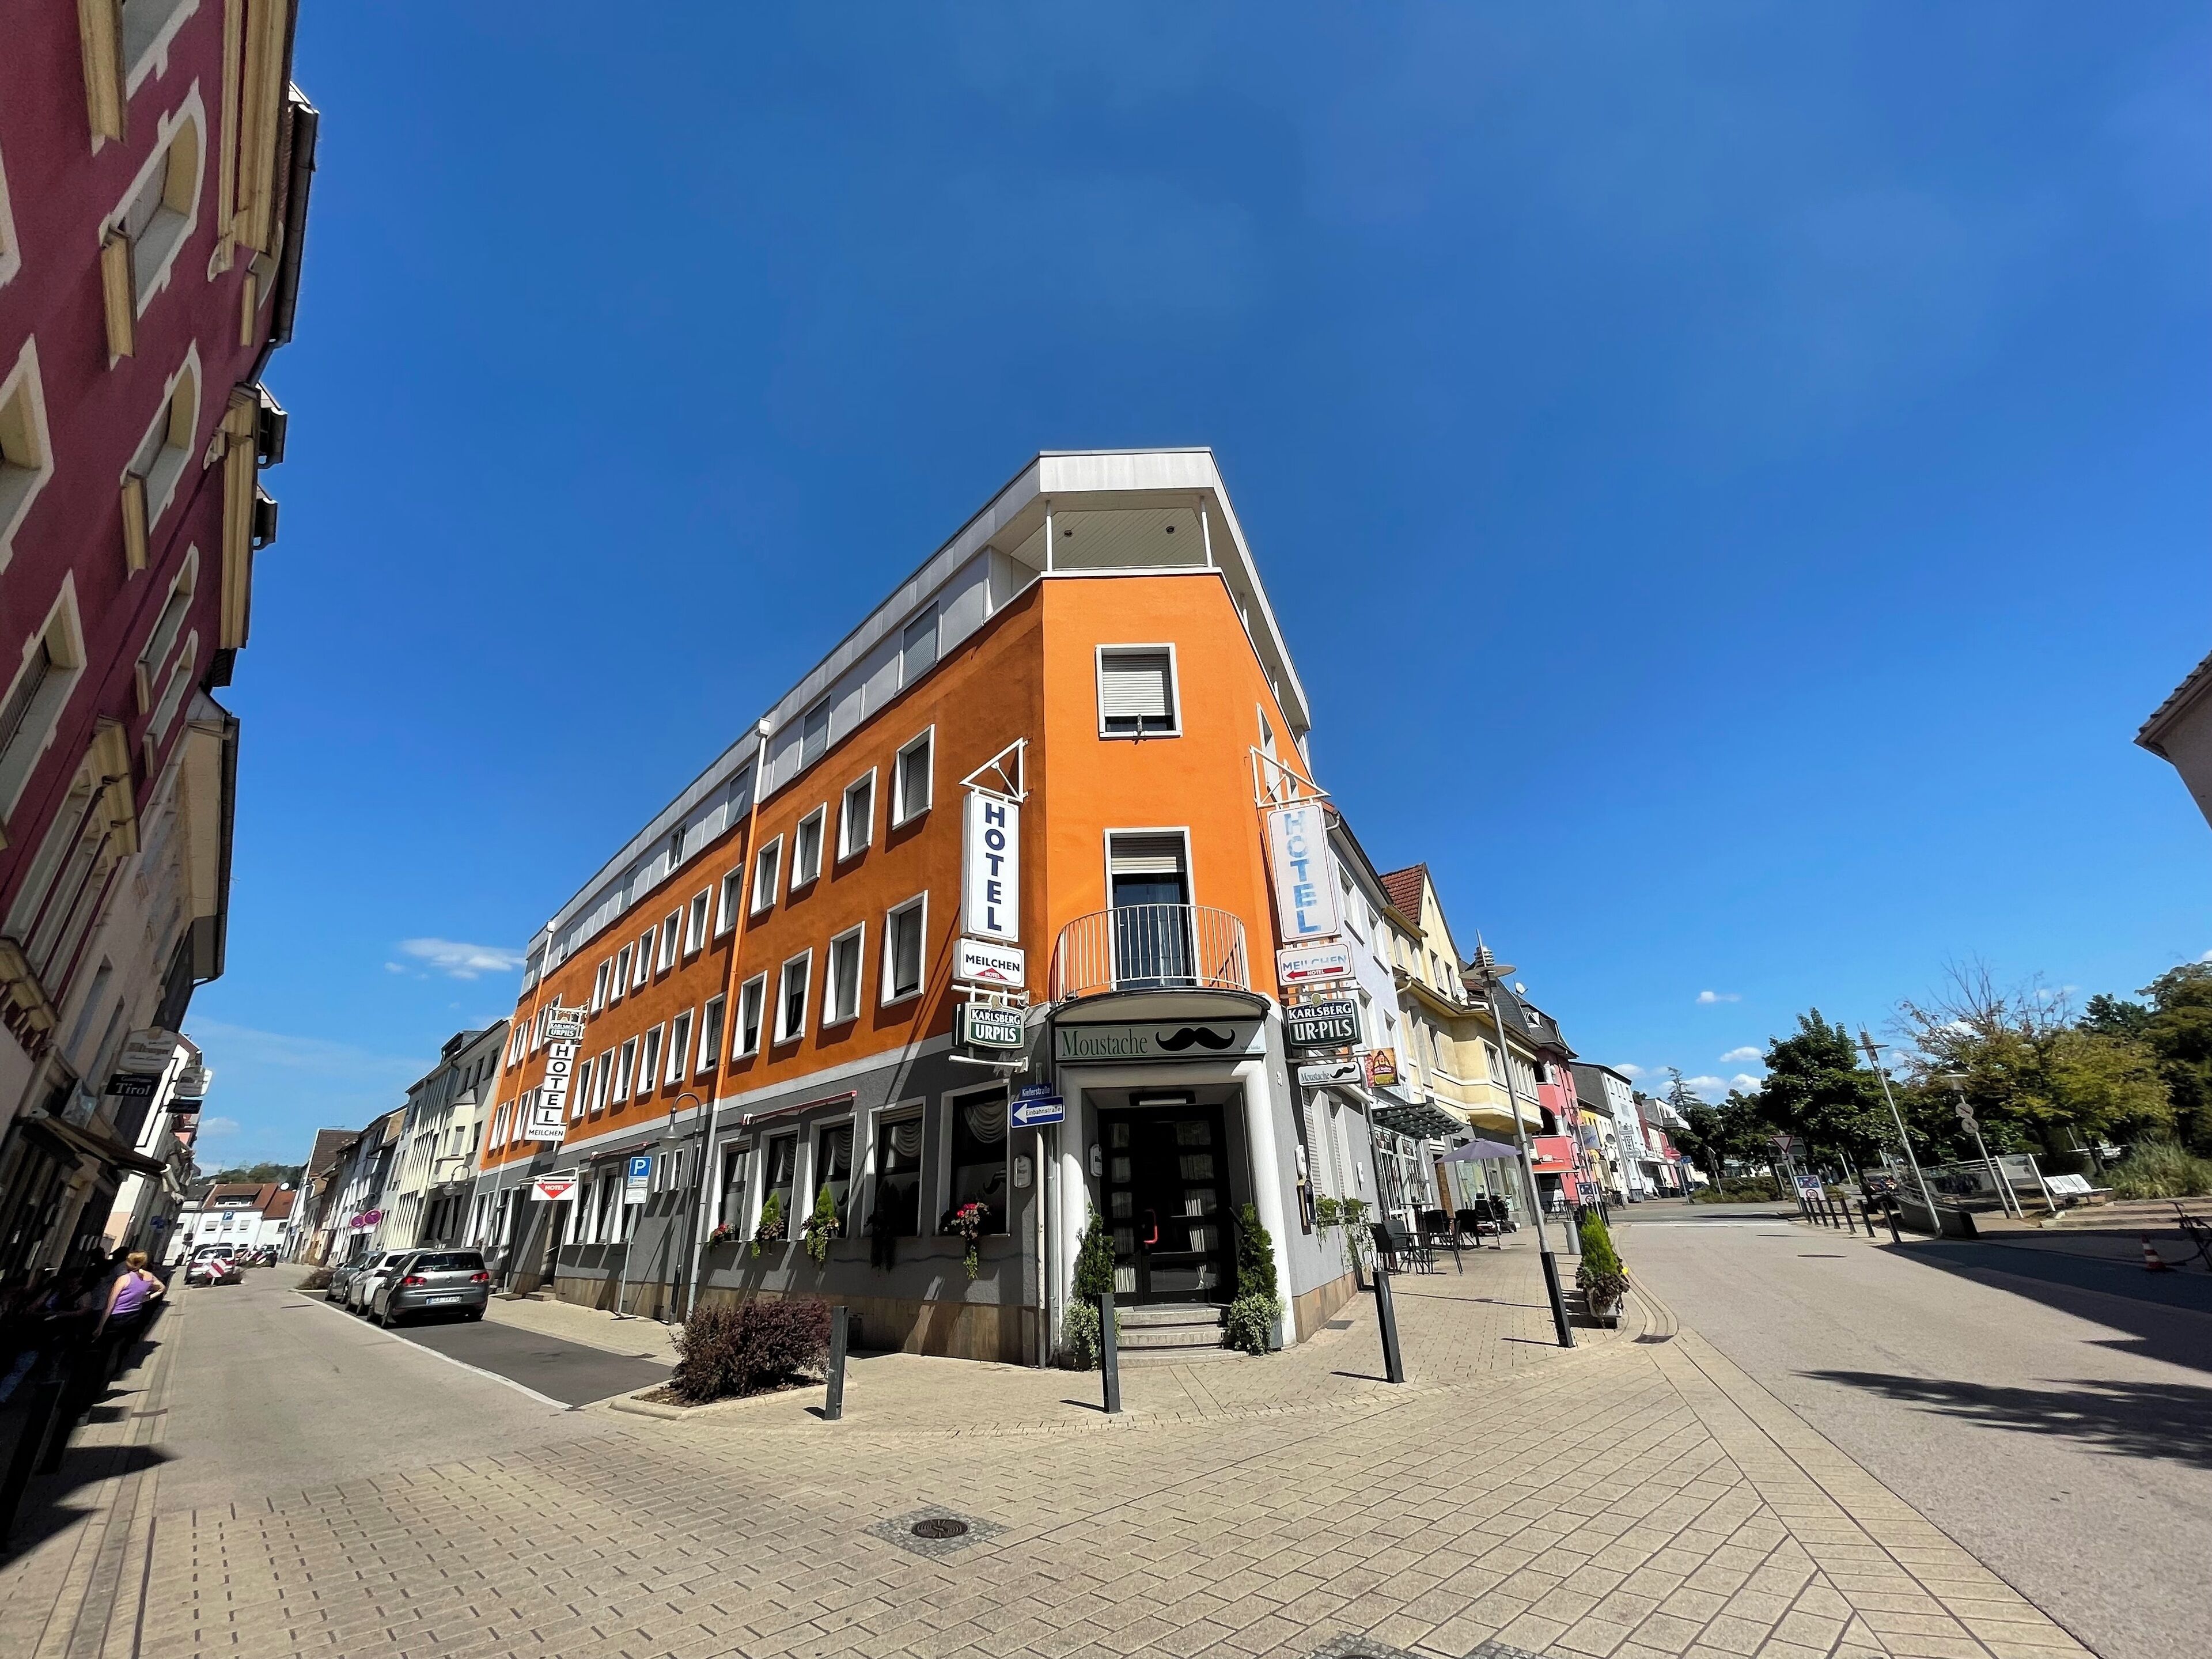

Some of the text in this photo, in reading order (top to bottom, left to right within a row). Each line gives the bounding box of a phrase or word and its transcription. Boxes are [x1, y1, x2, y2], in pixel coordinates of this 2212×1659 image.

[985, 802, 1005, 931] HOTEL
[1283, 810, 1321, 933] HOTEL
[965, 954, 1020, 972] MEILCHEN
[971, 1009, 1021, 1025] KARLSBERG
[1289, 1003, 1352, 1020] KARLSBERG
[975, 1024, 1017, 1042] URPILS
[1294, 1019, 1352, 1041] UR-PILS
[1061, 1028, 1148, 1056] Moustache
[544, 1046, 569, 1122] HOTEL
[1301, 1070, 1330, 1082] Moustache
[116, 1082, 151, 1095] Tirol
[1026, 1105, 1061, 1116] Einbahnstraße
[634, 1159, 646, 1175] P
